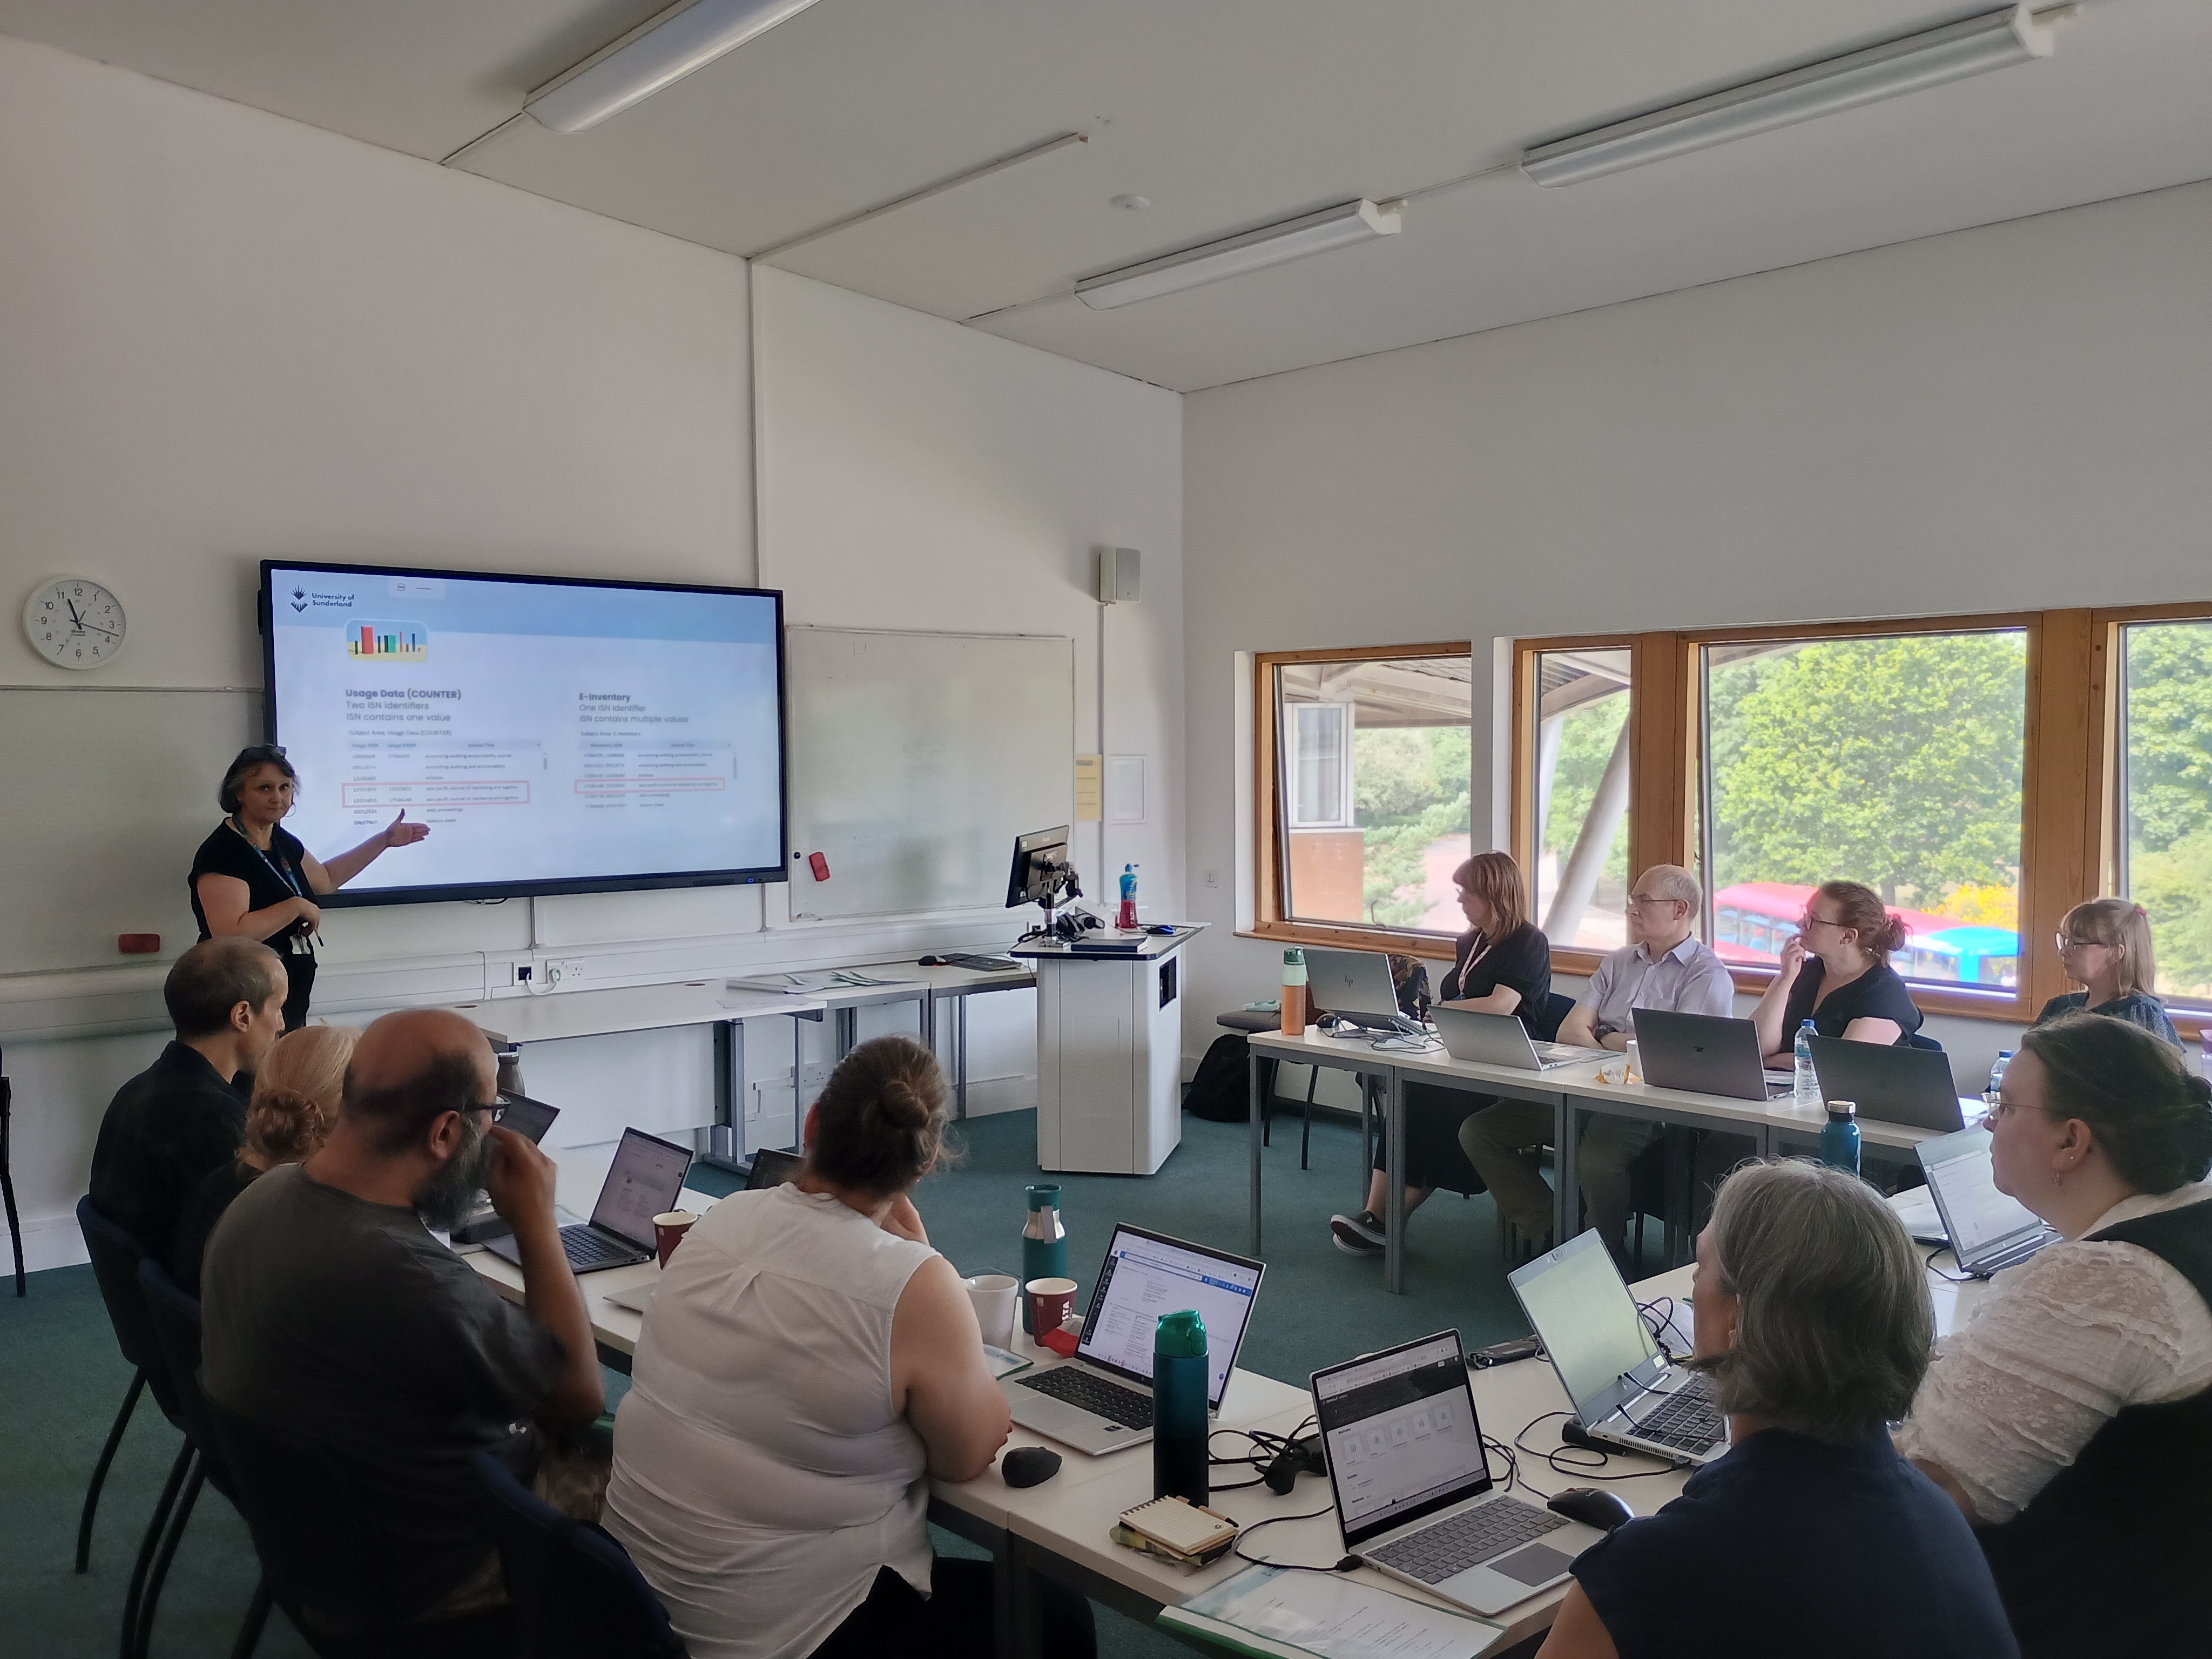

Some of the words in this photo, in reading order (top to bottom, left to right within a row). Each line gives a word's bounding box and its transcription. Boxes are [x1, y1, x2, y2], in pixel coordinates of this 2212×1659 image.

[73, 588, 83, 596] 12
[312, 592, 346, 601] University
[45, 602, 53, 610] 10
[104, 605, 111, 613] 2
[41, 616, 47, 624] 9
[46, 632, 52, 640] 8
[104, 636, 110, 644] 4
[58, 644, 64, 652] 7
[92, 646, 98, 655] 5
[346, 689, 378, 699] Usage
[380, 690, 404, 698] Data
[407, 688, 461, 700] (COUNTER)
[579, 693, 631, 703] E-Inventory
[385, 702, 429, 710] identifiers
[631, 716, 662, 724] multiple
